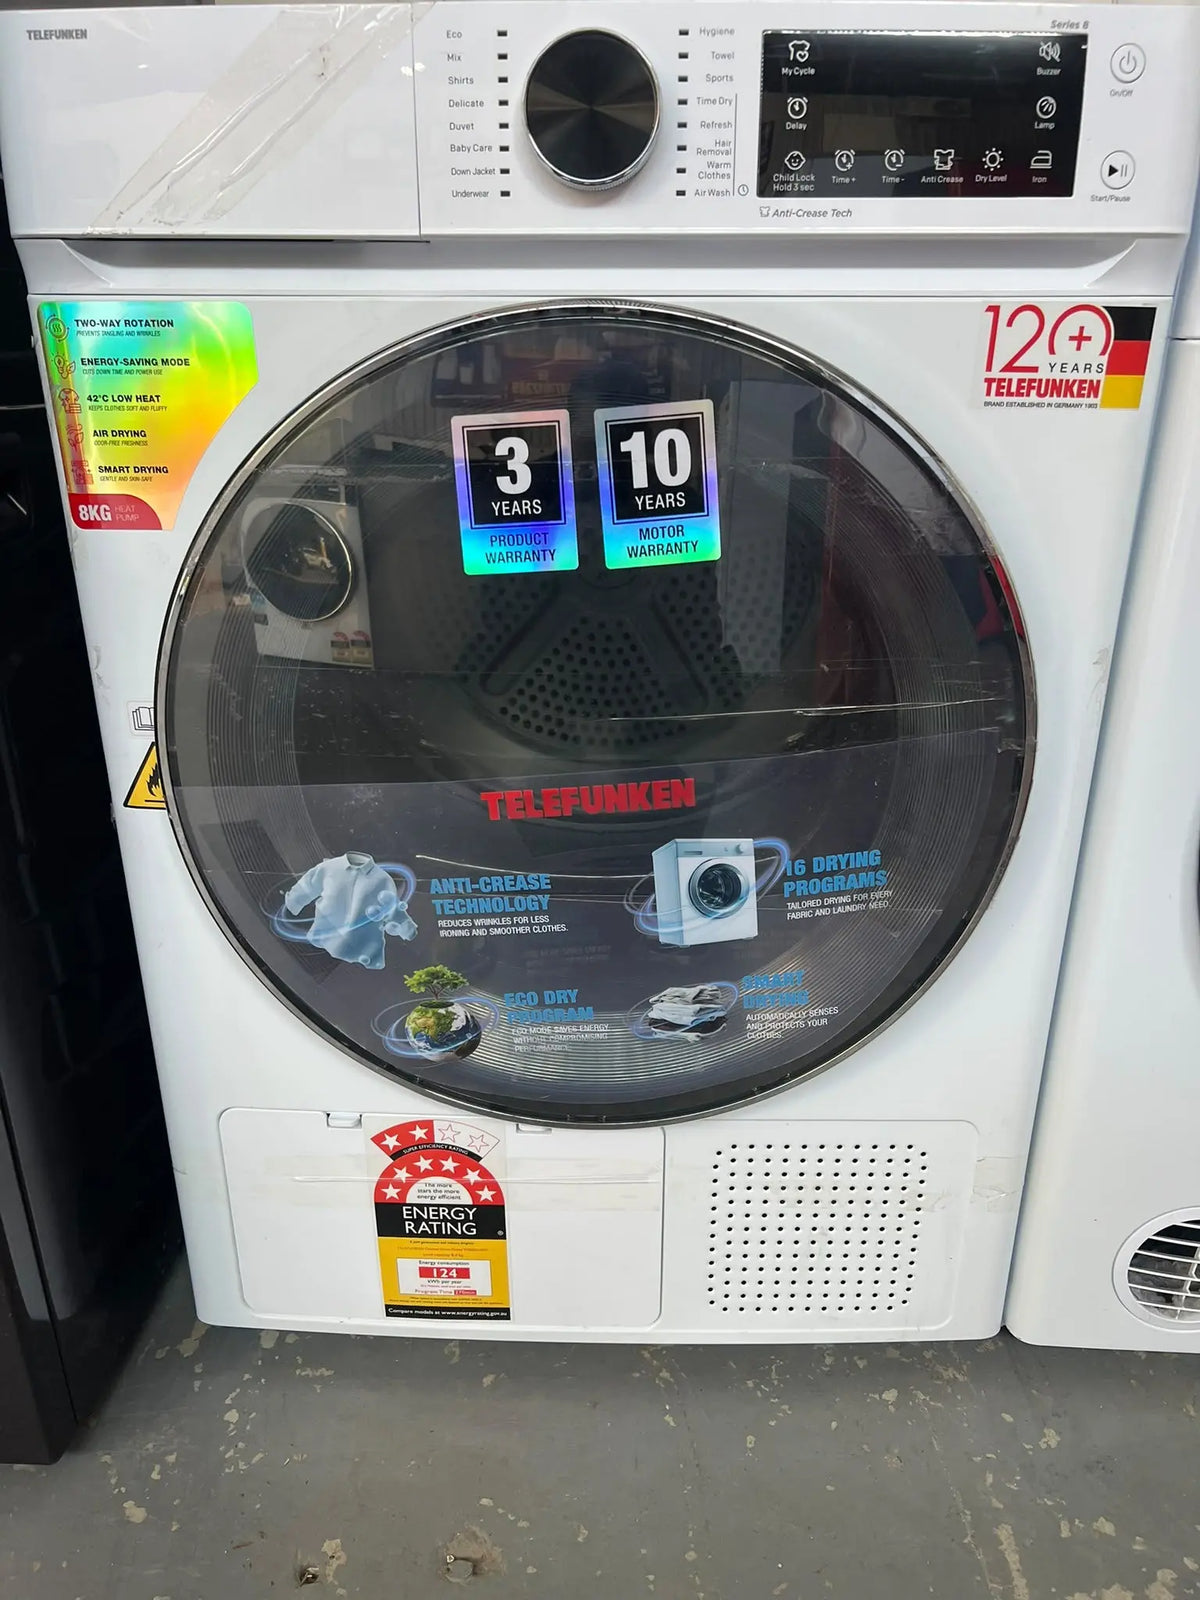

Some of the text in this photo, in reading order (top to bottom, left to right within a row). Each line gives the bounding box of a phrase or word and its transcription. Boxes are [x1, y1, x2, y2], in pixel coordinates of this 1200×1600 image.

[1050, 20, 1080, 29] Series
[26, 28, 87, 40] TELEFUNKEN
[446, 30, 462, 39] Eco
[699, 27, 735, 36] Hygiene
[447, 53, 462, 62] Mix
[711, 51, 734, 60] Towel
[782, 66, 816, 76] My Cycle
[1036, 66, 1061, 76] Buzzer
[448, 76, 474, 85] Shirts
[705, 74, 733, 83] Sports
[448, 99, 485, 108] Delicate
[696, 97, 733, 107] Time Dry
[449, 122, 474, 131] Duvet
[700, 120, 732, 129] Refresh
[786, 122, 807, 131] Delay
[1034, 121, 1055, 131] Lamp
[715, 139, 732, 148] Hair
[450, 144, 493, 154] Baby Care
[696, 147, 732, 156] Removal
[707, 161, 731, 170] Warm
[451, 167, 496, 176] Down Jacket
[698, 171, 731, 180] Clothes
[773, 174, 816, 183] Child Lock
[831, 176, 850, 184] Time
[882, 176, 900, 184] Time
[938, 176, 964, 184] Crease
[975, 174, 1007, 183] Dry Level
[1032, 175, 1047, 183] Iron
[694, 188, 731, 197] Air Wash
[773, 183, 815, 192] Hold 3 sec
[451, 190, 490, 198] Underwear
[772, 208, 852, 219] Anti-Crease Tech
[74, 319, 174, 328] TWO-WAY ROTATION
[81, 358, 190, 367] ENERGY-SAVING MODE
[1049, 363, 1104, 374] YEARS
[984, 378, 1101, 399] TELEFUNKEN
[112, 394, 133, 403] LOW
[135, 394, 161, 403] HEAT
[93, 430, 146, 438] AIR DRYING
[620, 428, 692, 490] 10
[98, 466, 168, 474] SMART DRYING
[494, 436, 532, 495] 3
[635, 492, 686, 510] YEARS
[78, 504, 112, 522] 8KG
[114, 505, 136, 513] HEAT
[491, 499, 542, 517] YEARS
[639, 525, 685, 540] MOTOR
[490, 532, 549, 547] PRODUCT
[626, 540, 699, 558] WARRANTY
[485, 549, 556, 564] WARRANTY
[480, 778, 696, 821] TELEFUNKEN
[786, 849, 881, 876] 16 DRYING
[430, 873, 551, 895] ANTI-CREASE
[783, 870, 888, 898] PROGRAMS
[432, 895, 550, 915] TECHNOLOGY
[787, 890, 893, 910] TAILORED DRYING FOR EVERY
[787, 903, 867, 920] FABRIC AND LAUNDRY
[438, 915, 549, 927] REDUCES WRINKLES FOR LESS
[440, 924, 568, 937] IRONING AND SMOOTHER CLOTHES.
[741, 969, 805, 991] SMART
[503, 989, 578, 1007] ECO DRY
[743, 990, 809, 1009] DRYING
[507, 1006, 594, 1024] PROGRAM
[746, 1007, 839, 1021] AUTOMATICALLY SENSES
[764, 1020, 805, 1029] PROTECTS
[807, 1018, 828, 1027] YOUR
[529, 1026, 551, 1034] MODE
[553, 1025, 577, 1033] SAVES
[579, 1024, 609, 1032] ENERGY
[403, 1146, 418, 1154] SUPER
[449, 1146, 468, 1154] RATING
[402, 1206, 477, 1221] ENERGY
[405, 1221, 477, 1235] RATING
[433, 1269, 457, 1278] 124
